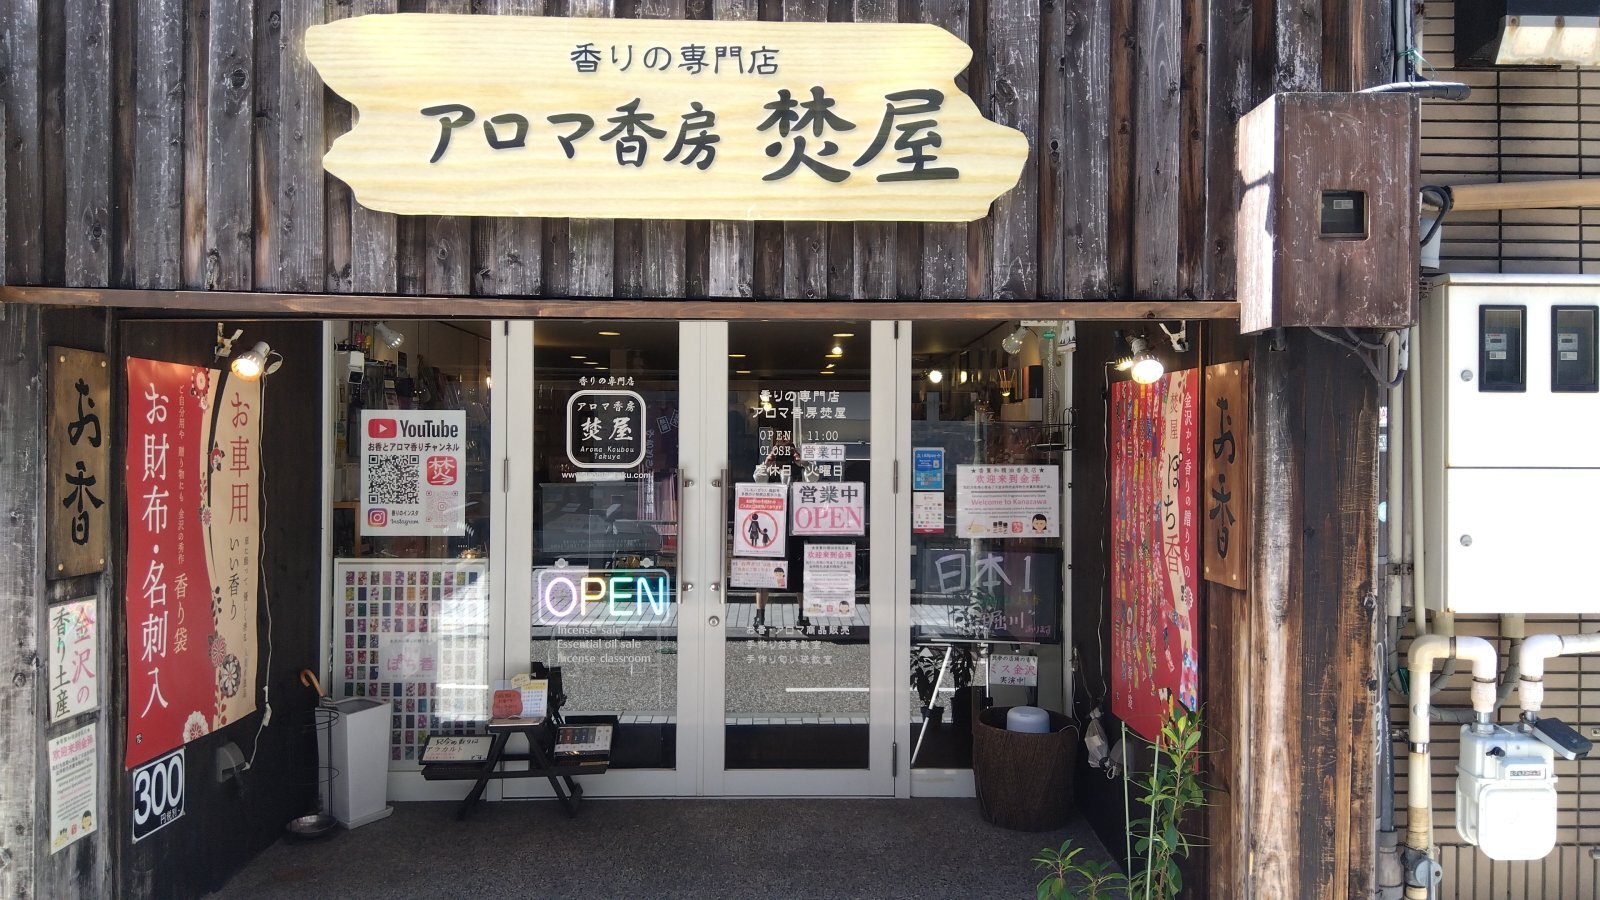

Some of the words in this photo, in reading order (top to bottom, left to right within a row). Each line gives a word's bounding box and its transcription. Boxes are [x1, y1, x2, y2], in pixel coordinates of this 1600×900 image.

[570, 43, 779, 75] 香りの専門店
[420, 97, 721, 171] アロマ香房
[756, 86, 960, 183] 焚屋
[578, 376, 635, 386] 香りの専門店
[576, 401, 636, 412] アロマ香房
[759, 389, 840, 403] 香りの専門店
[752, 406, 847, 419] アロマ香房焚屋
[1169, 391, 1180, 440] 焚屋
[399, 419, 459, 438] YouTube
[580, 416, 634, 441] 焚屋
[759, 430, 792, 441] OPEN
[807, 430, 839, 441] 11:00
[228, 391, 250, 525] お車用
[367, 442, 460, 452] お香とアロマ香りチャンネル
[580, 445, 603, 453] Aroma
[607, 445, 635, 453] Koubou
[759, 445, 791, 456] CLOSE
[803, 445, 843, 459] 営業中
[62, 377, 105, 546] お香
[755, 465, 792, 477] 定休日
[806, 465, 843, 477] 火曜日
[1182, 391, 1193, 579] 金沢から香りの贈りもの
[1208, 396, 1237, 560] お香
[799, 485, 859, 504] 営業中
[971, 498, 1003, 506] Welcome
[1012, 498, 1047, 506] Kanazawa
[794, 506, 864, 529] OPEN
[1163, 450, 1184, 574] ぽち香
[141, 382, 170, 719] お財布・名刺入
[227, 537, 241, 621] いい香り
[544, 576, 664, 617] OPEN
[173, 572, 189, 655] 香り袋
[557, 625, 597, 635] Incense
[72, 605, 96, 704] 金沢の
[557, 639, 601, 649] Essential
[604, 639, 617, 649] oil
[620, 639, 642, 649] sale
[52, 606, 71, 719] 香り土産
[557, 653, 597, 663] Incense
[600, 653, 651, 663] classroom
[134, 754, 183, 826] 300
